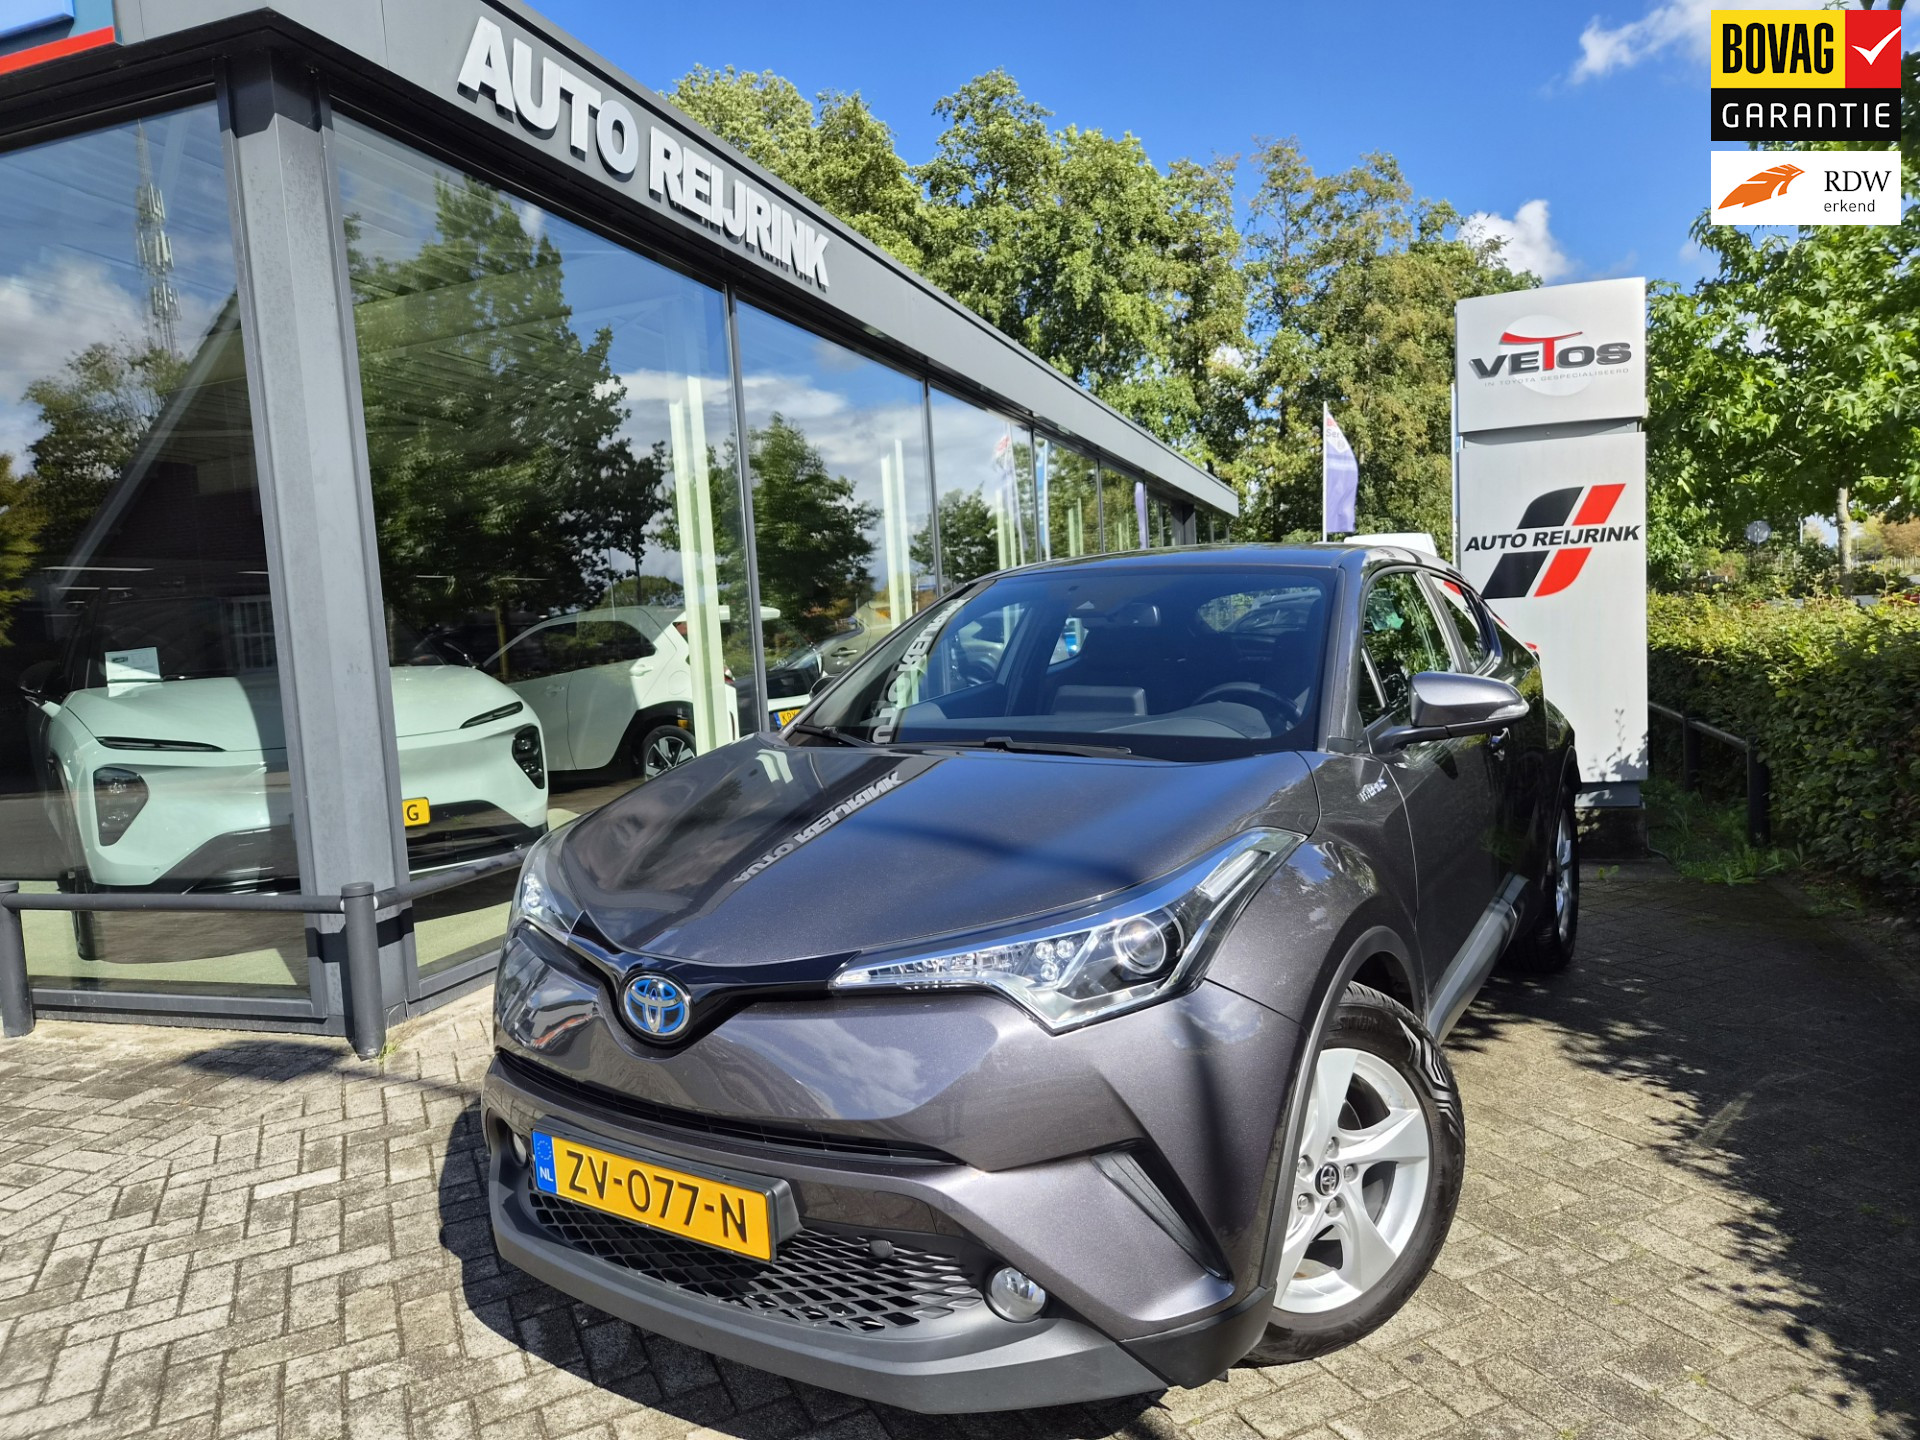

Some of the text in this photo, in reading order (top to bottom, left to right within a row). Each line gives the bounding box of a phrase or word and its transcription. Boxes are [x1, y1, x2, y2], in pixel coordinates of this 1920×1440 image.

[457, 16, 830, 288] AUTO REIJRINK
[1469, 331, 1632, 380] VETOS
[1500, 377, 1537, 386] TOYOTA
[1540, 367, 1630, 382] GESPECIALISEERD
[1464, 525, 1642, 552] AUTO REIJRINK
[539, 1166, 554, 1182] NL
[566, 1150, 749, 1244] ZV-077-N
